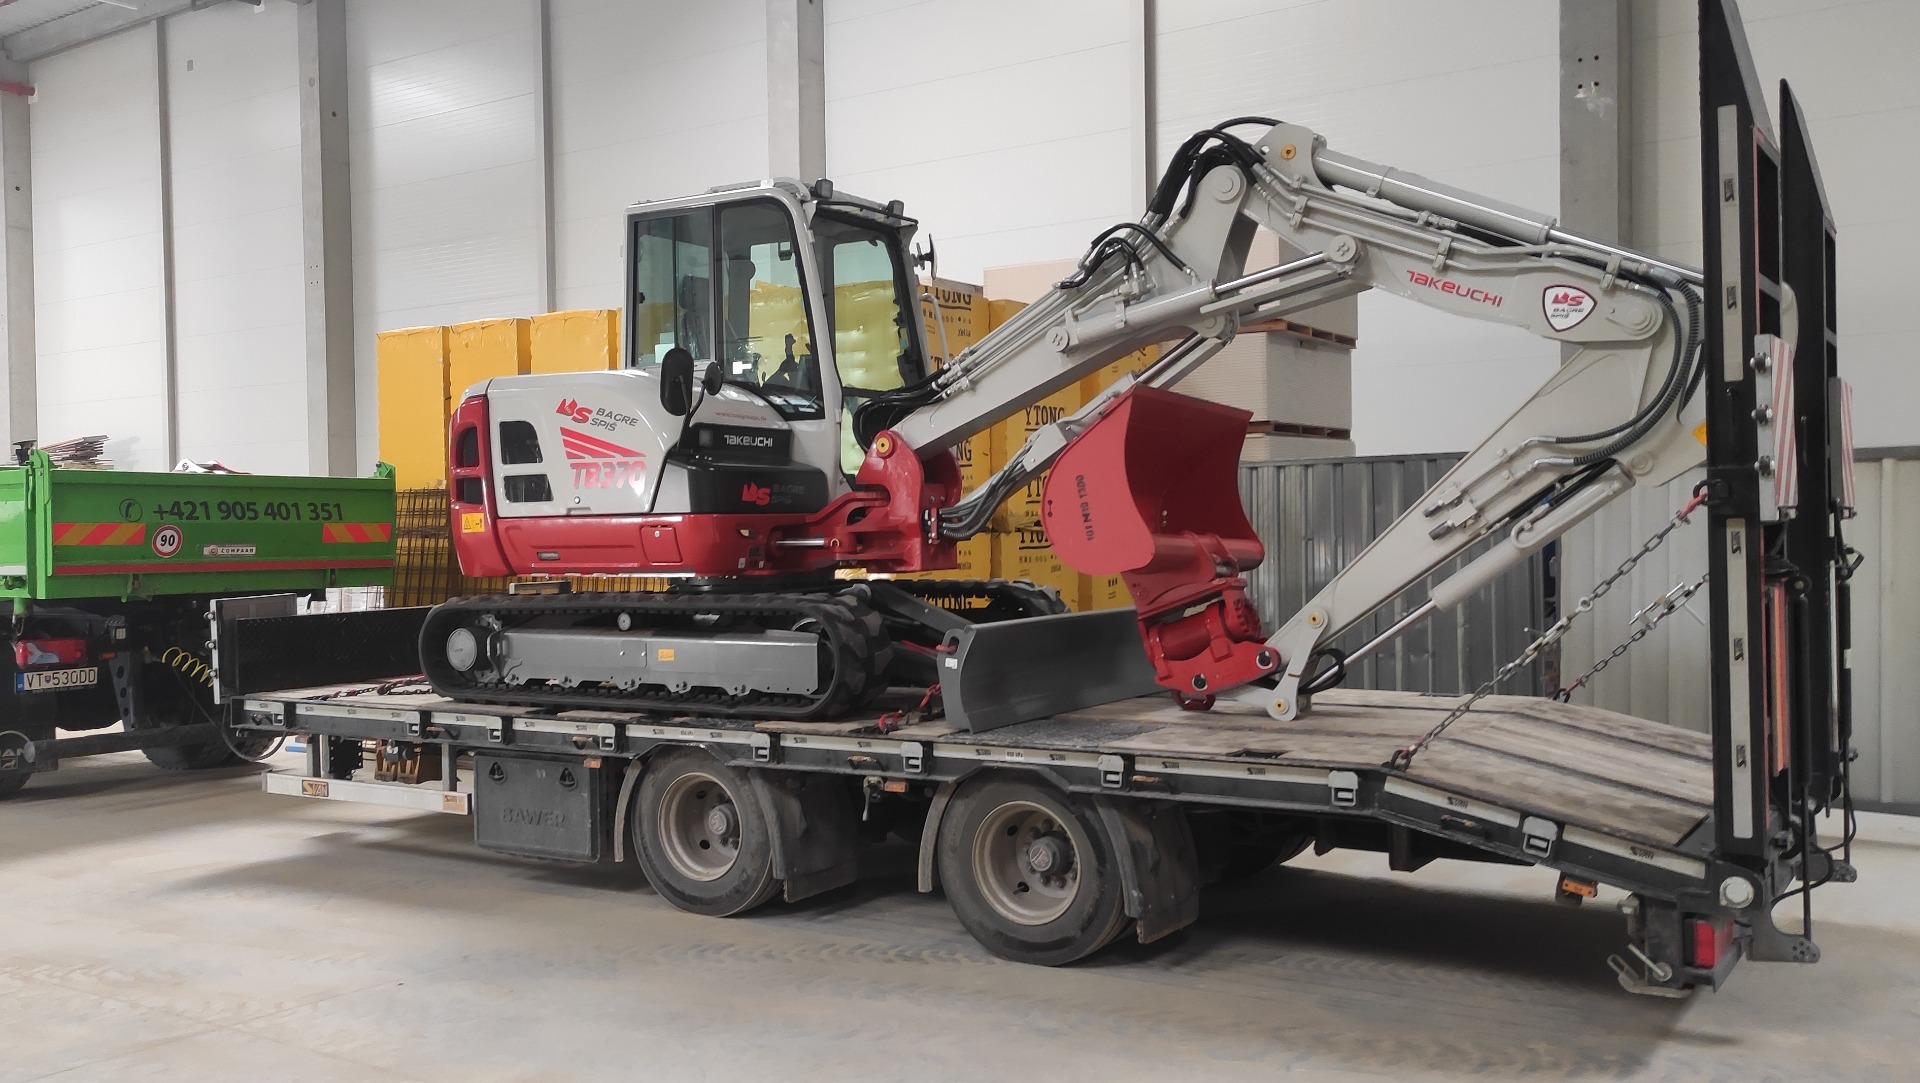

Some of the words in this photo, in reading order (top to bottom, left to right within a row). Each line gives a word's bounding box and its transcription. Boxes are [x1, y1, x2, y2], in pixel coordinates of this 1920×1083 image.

[589, 417, 618, 432] SPIŠ
[595, 407, 639, 427] BAGRE
[569, 460, 646, 489] TB370
[153, 500, 211, 521] +421
[217, 501, 259, 521] 905
[263, 502, 301, 521] 401
[307, 502, 343, 521] 351
[159, 534, 175, 547] 90
[26, 673, 44, 688] VT
[52, 668, 96, 686] 530DD
[302, 780, 328, 797] SVAN
